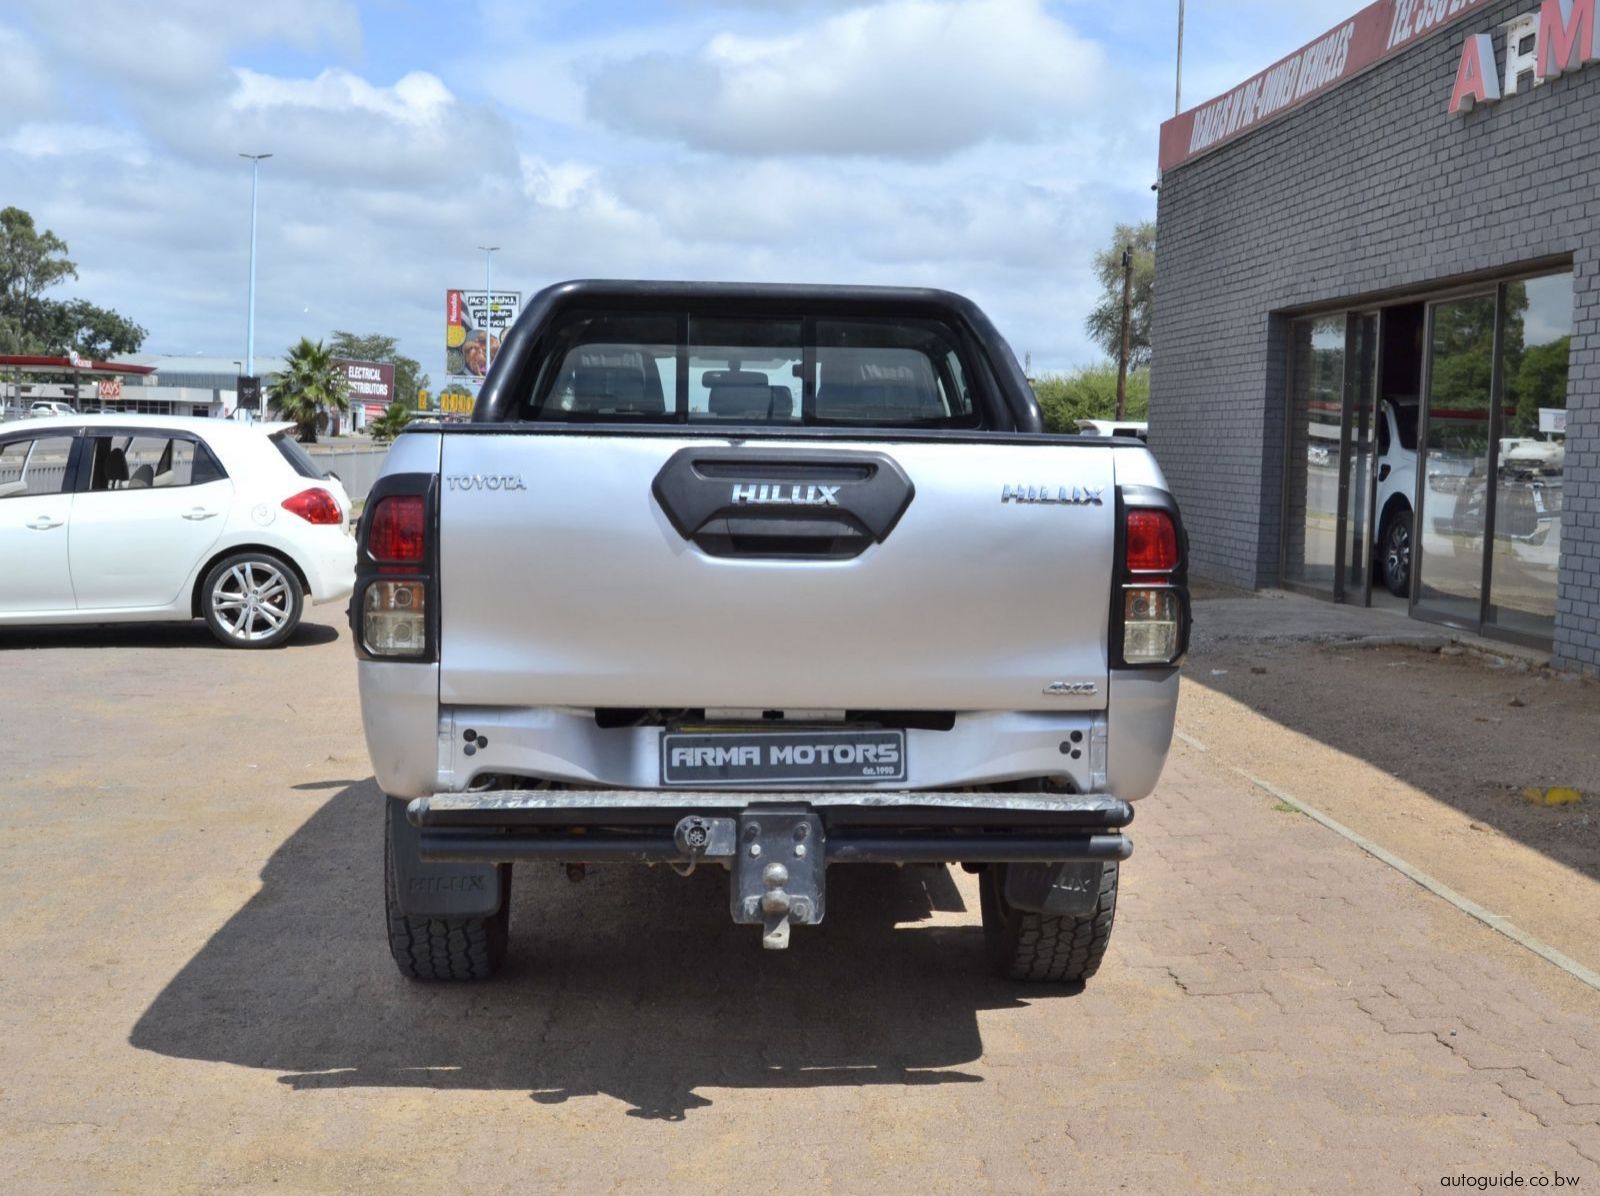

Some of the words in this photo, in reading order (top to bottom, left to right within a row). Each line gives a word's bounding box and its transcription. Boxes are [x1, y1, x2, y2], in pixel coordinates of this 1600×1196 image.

[1189, 94, 1233, 154] DEALERS
[1295, 22, 1355, 100] VEHICLES
[348, 365, 381, 381] ELECTRICAL
[446, 474, 527, 490] TOYOTA
[731, 484, 840, 505] HILUX
[1001, 482, 1103, 506] HILUX
[671, 746, 761, 768] ARMA
[769, 743, 899, 766] MOTORS
